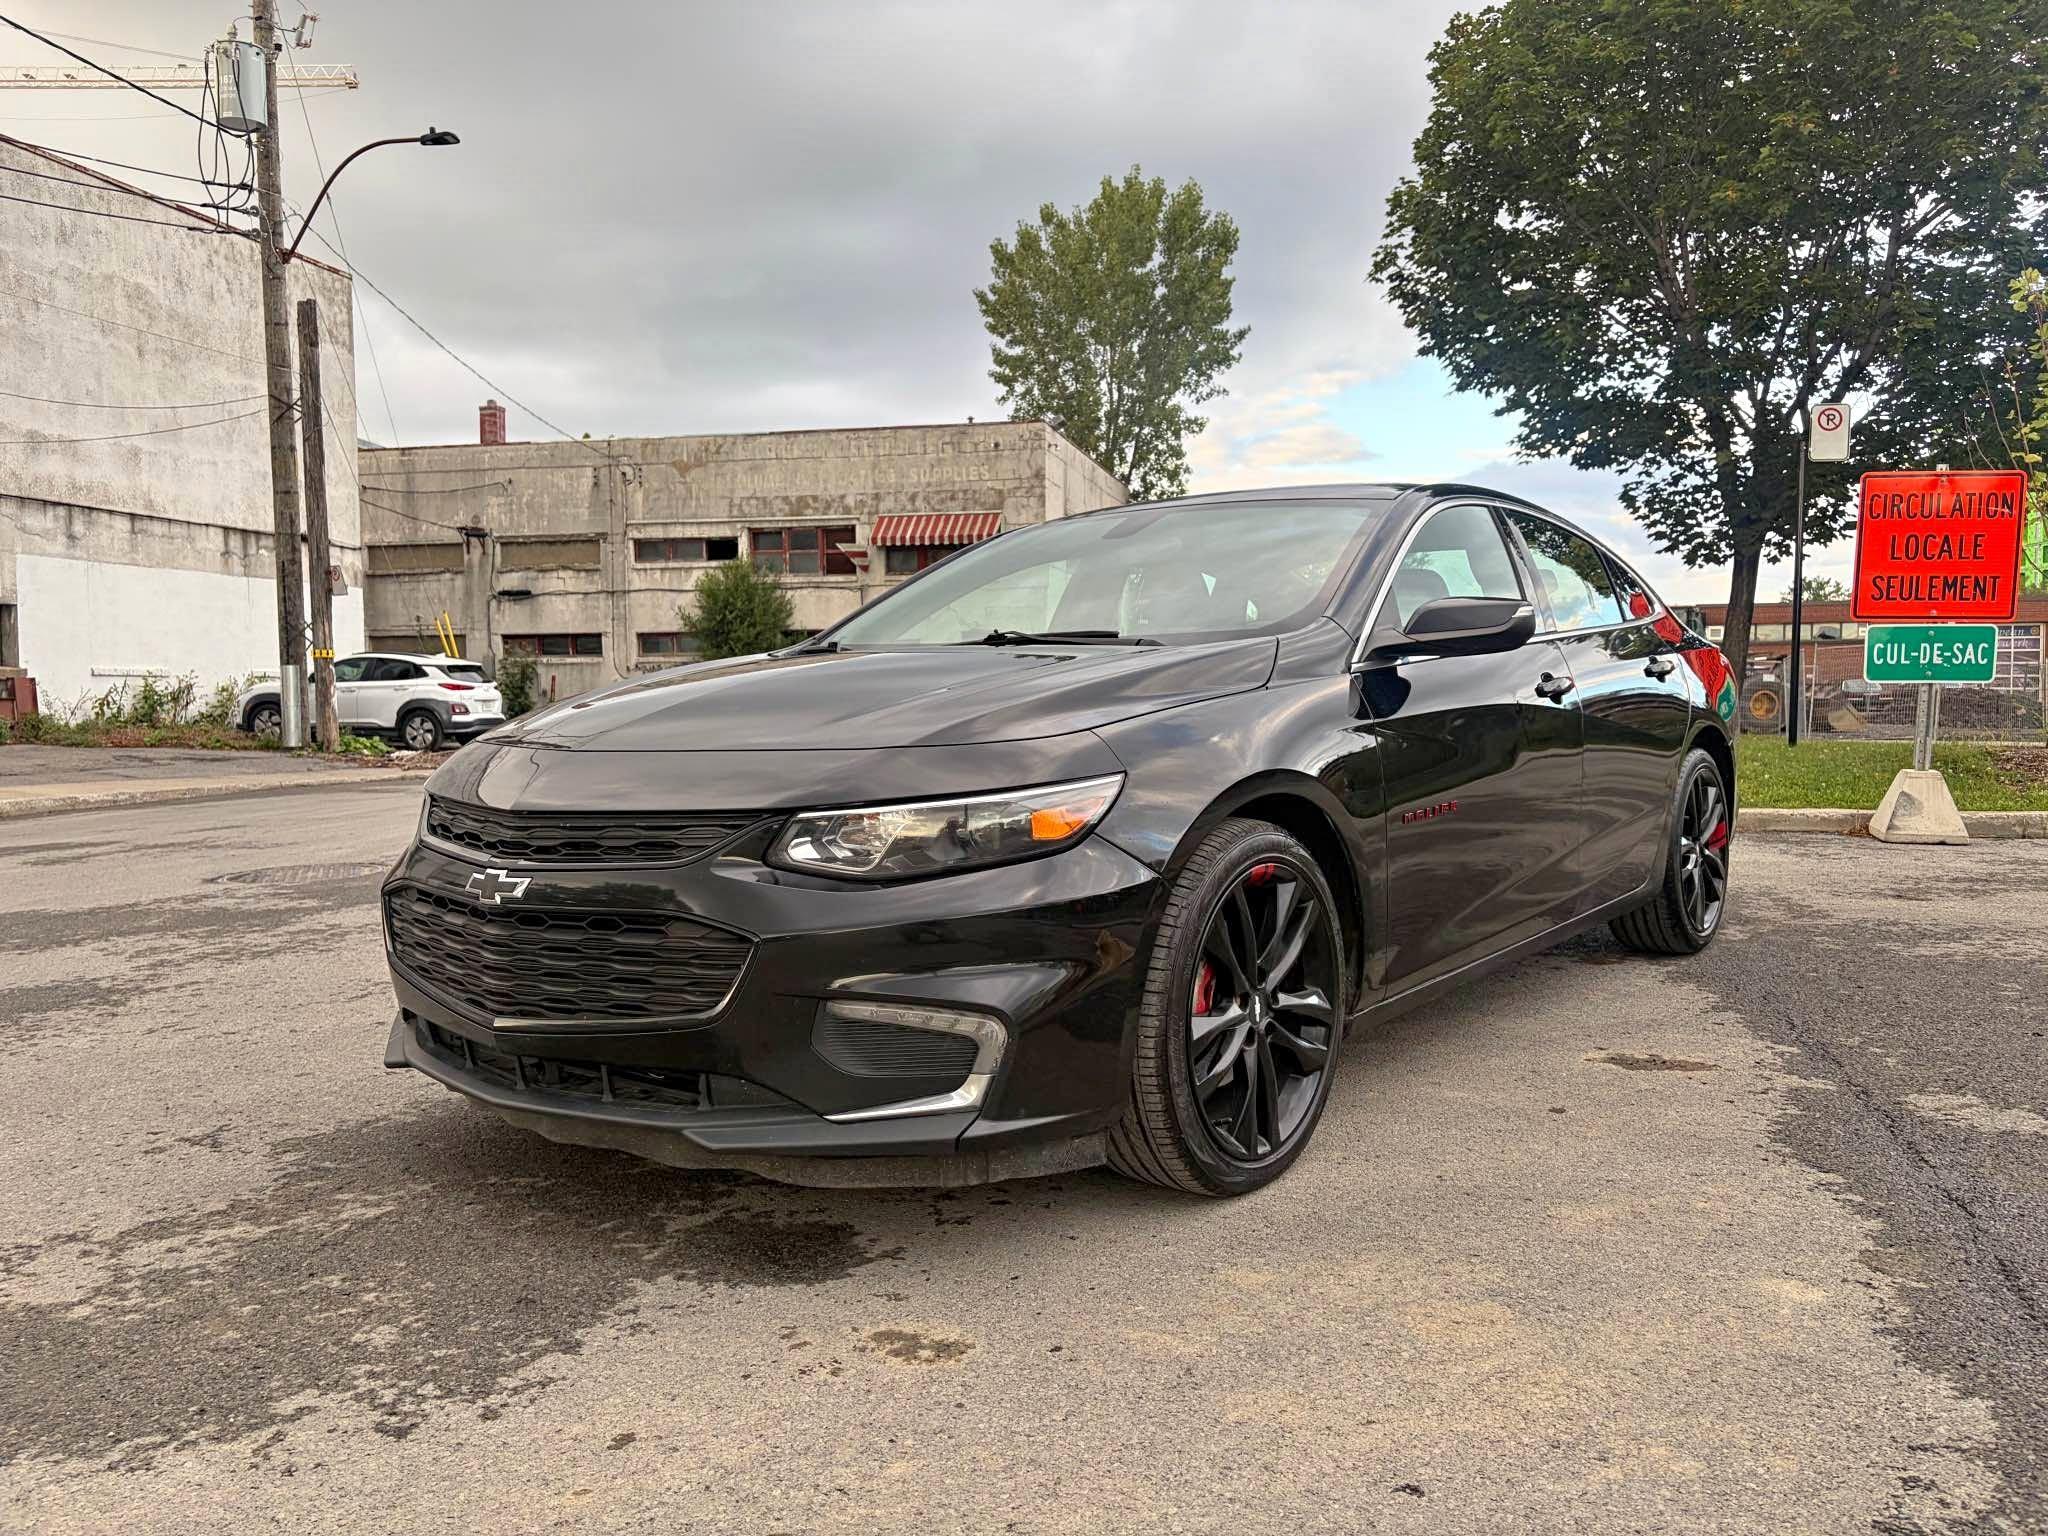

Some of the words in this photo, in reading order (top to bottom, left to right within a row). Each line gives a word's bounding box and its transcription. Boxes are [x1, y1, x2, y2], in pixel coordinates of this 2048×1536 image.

[909, 465, 990, 482] SUPPLIES
[1868, 492, 2015, 520] CIRCULATION
[1890, 534, 1986, 561] LOCALE
[1870, 575, 2001, 602] SEULEMENT
[1872, 642, 1989, 665] CUL-DE-SAC
